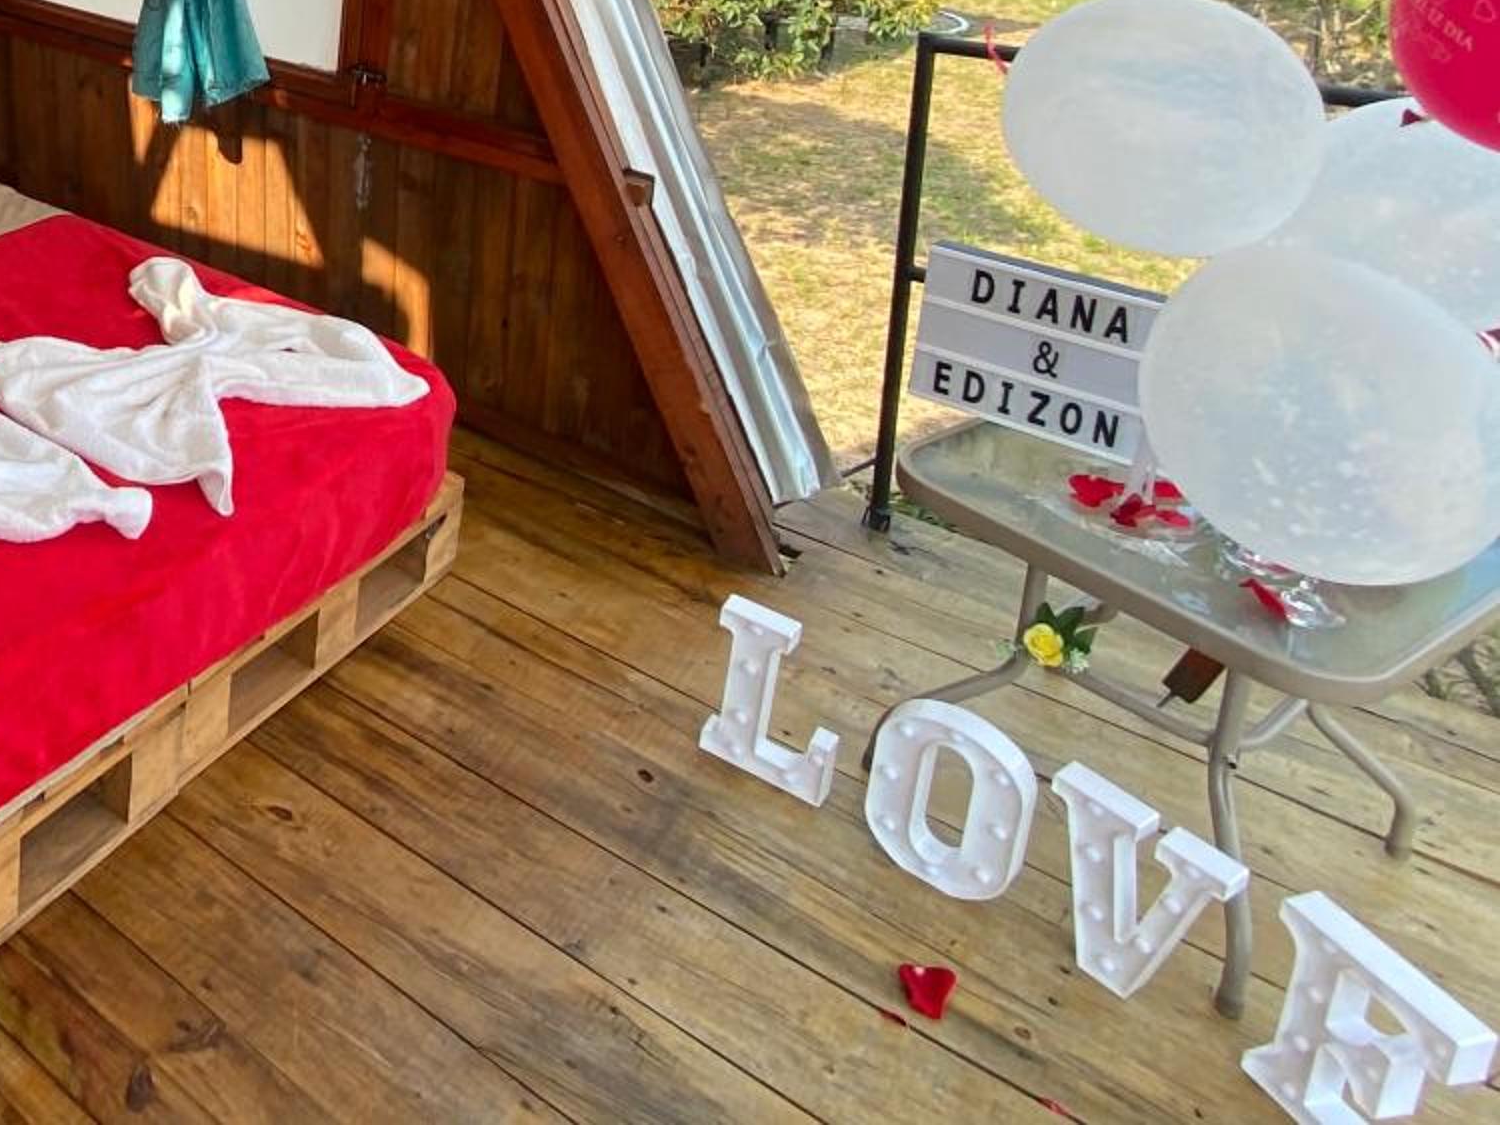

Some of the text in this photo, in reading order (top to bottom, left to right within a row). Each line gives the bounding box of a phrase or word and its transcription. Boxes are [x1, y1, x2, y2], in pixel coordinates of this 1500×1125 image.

[971, 269, 1129, 344] DIANA
[1033, 340, 1060, 378] &
[933, 360, 1120, 448] EDIZON
[699, 594, 1500, 1125] LOVE
